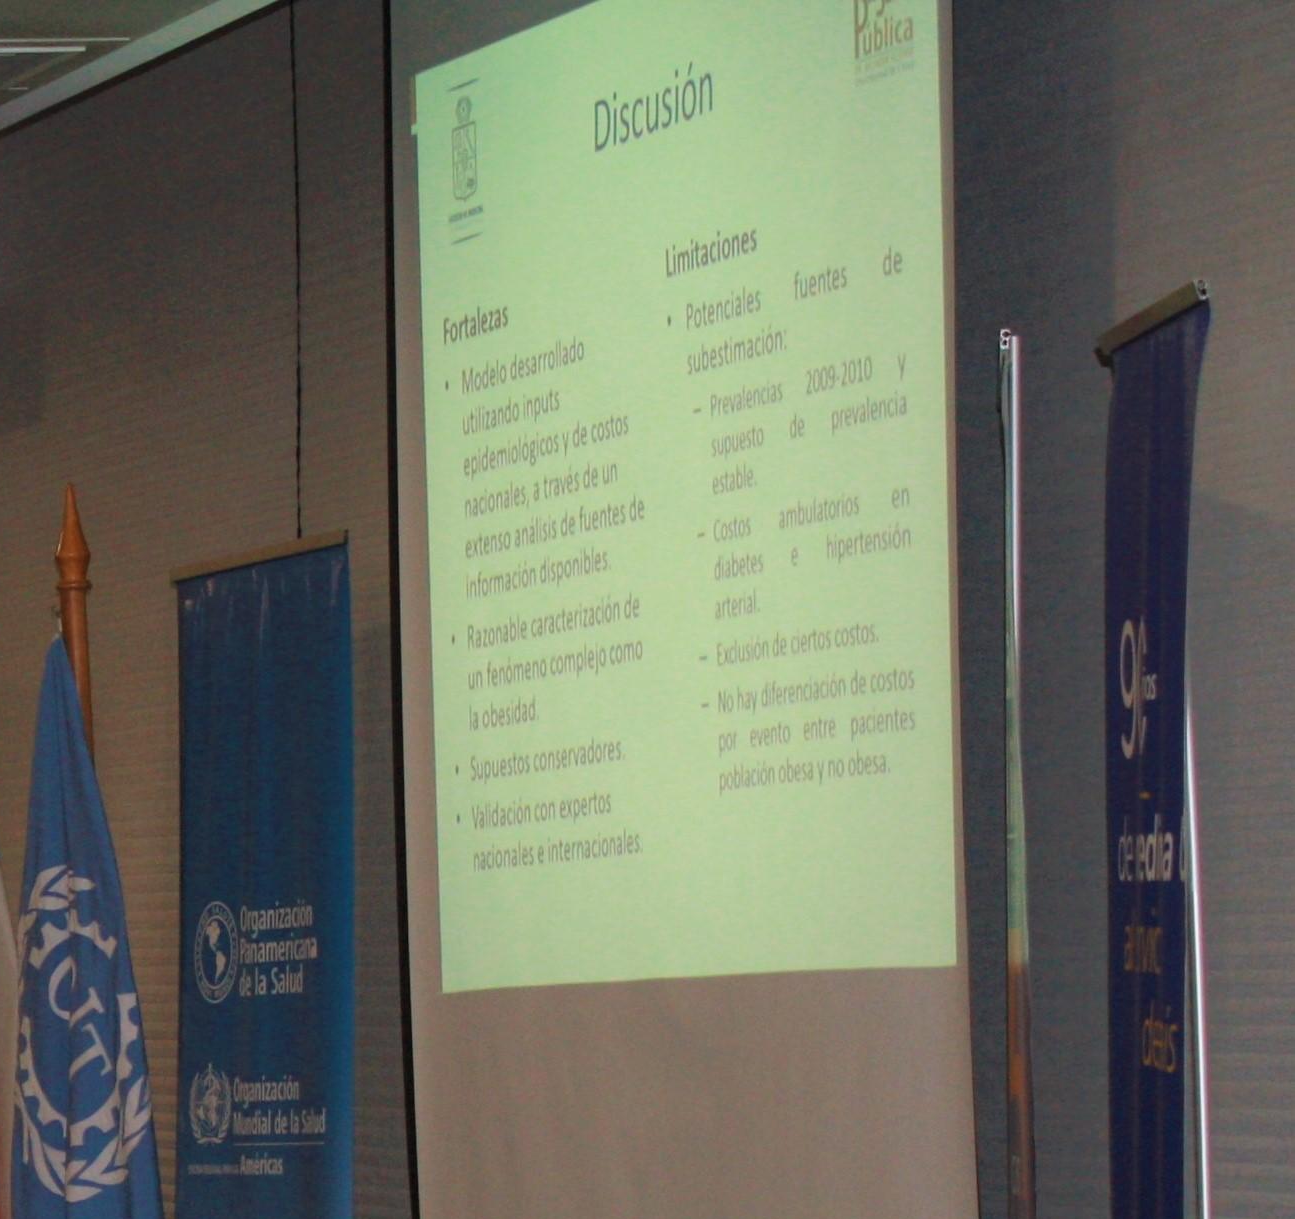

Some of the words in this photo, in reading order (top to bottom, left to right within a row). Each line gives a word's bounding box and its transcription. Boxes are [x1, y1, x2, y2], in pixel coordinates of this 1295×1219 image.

[594, 62, 713, 152] Discusión
[665, 228, 757, 278] Limitaciones
[686, 287, 762, 330] Potenciales
[794, 266, 848, 301] fuentes
[882, 245, 903, 277] de
[443, 306, 509, 344] Fortalezas
[687, 323, 787, 375] subestimación:
[462, 359, 507, 394] Modelo
[511, 336, 585, 380] desarrollado
[710, 378, 783, 417] Prevalencias
[805, 355, 872, 395] 2009-2010
[898, 352, 907, 381] y
[463, 398, 520, 435] utilizando
[523, 389, 560, 422] inputs
[711, 426, 764, 458] supuesto
[789, 412, 806, 439] de
[831, 390, 908, 436] prevalencia
[463, 432, 559, 480] epidemiológicos
[562, 434, 570, 456] y
[572, 421, 588, 448] de
[591, 414, 629, 444] costos
[465, 482, 530, 519] nacionales,
[533, 482, 540, 502] a
[543, 466, 580, 499] través
[583, 463, 598, 489] de
[602, 462, 618, 484] un
[712, 463, 757, 495] estable.
[465, 527, 511, 559] extenso
[515, 512, 557, 548] análisis
[561, 511, 576, 537] de
[579, 501, 626, 533] fuentes
[629, 493, 645, 521] de
[713, 516, 751, 543] Costos
[779, 494, 860, 529] ambulatorios
[891, 487, 910, 509] en
[466, 558, 536, 599] información
[540, 548, 612, 592] disponibles.
[714, 552, 763, 581] diabetes
[791, 547, 799, 567] e
[826, 522, 911, 565] hipertensión
[467, 615, 527, 649] Razonable
[531, 595, 620, 638] caracterización
[624, 593, 640, 618] de
[715, 589, 760, 619] arterial.
[468, 666, 483, 690] un
[487, 655, 547, 688] fenómeno
[550, 642, 607, 679] complejo
[609, 640, 643, 665] como
[717, 634, 769, 667] Exclusión
[772, 632, 787, 658] de
[790, 627, 831, 654] ciertos
[834, 623, 879, 647] costos.
[469, 705, 479, 731] la
[482, 695, 539, 728] obesidad.
[717, 690, 733, 713] No
[737, 686, 757, 715] hay
[761, 672, 846, 708] diferenciación
[850, 669, 867, 696] de
[870, 669, 915, 693] costos
[719, 731, 738, 757] por
[750, 721, 791, 747] evento
[803, 717, 836, 741] entre
[851, 709, 915, 742] pacientes
[470, 752, 531, 784] Supuestos
[533, 736, 626, 771] conservadores.
[719, 758, 775, 796] población
[778, 757, 813, 784] obesa
[817, 762, 825, 785] y
[827, 757, 845, 777] no
[848, 750, 891, 776] obesa.
[472, 796, 531, 829] Validación
[534, 799, 556, 822] con
[560, 792, 611, 823] expertos
[473, 841, 535, 872] nacionales
[537, 845, 545, 864] e
[548, 828, 643, 864] internacionales.
[240, 899, 313, 939] Organización
[239, 932, 318, 964] Panamericana
[239, 969, 251, 997] de
[254, 966, 267, 995] la
[271, 962, 303, 994] Salud
[233, 1075, 300, 1110] Organización
[233, 1108, 272, 1136] Mundial
[274, 1108, 288, 1134] de
[290, 1107, 300, 1133] la
[302, 1106, 325, 1134] Salud
